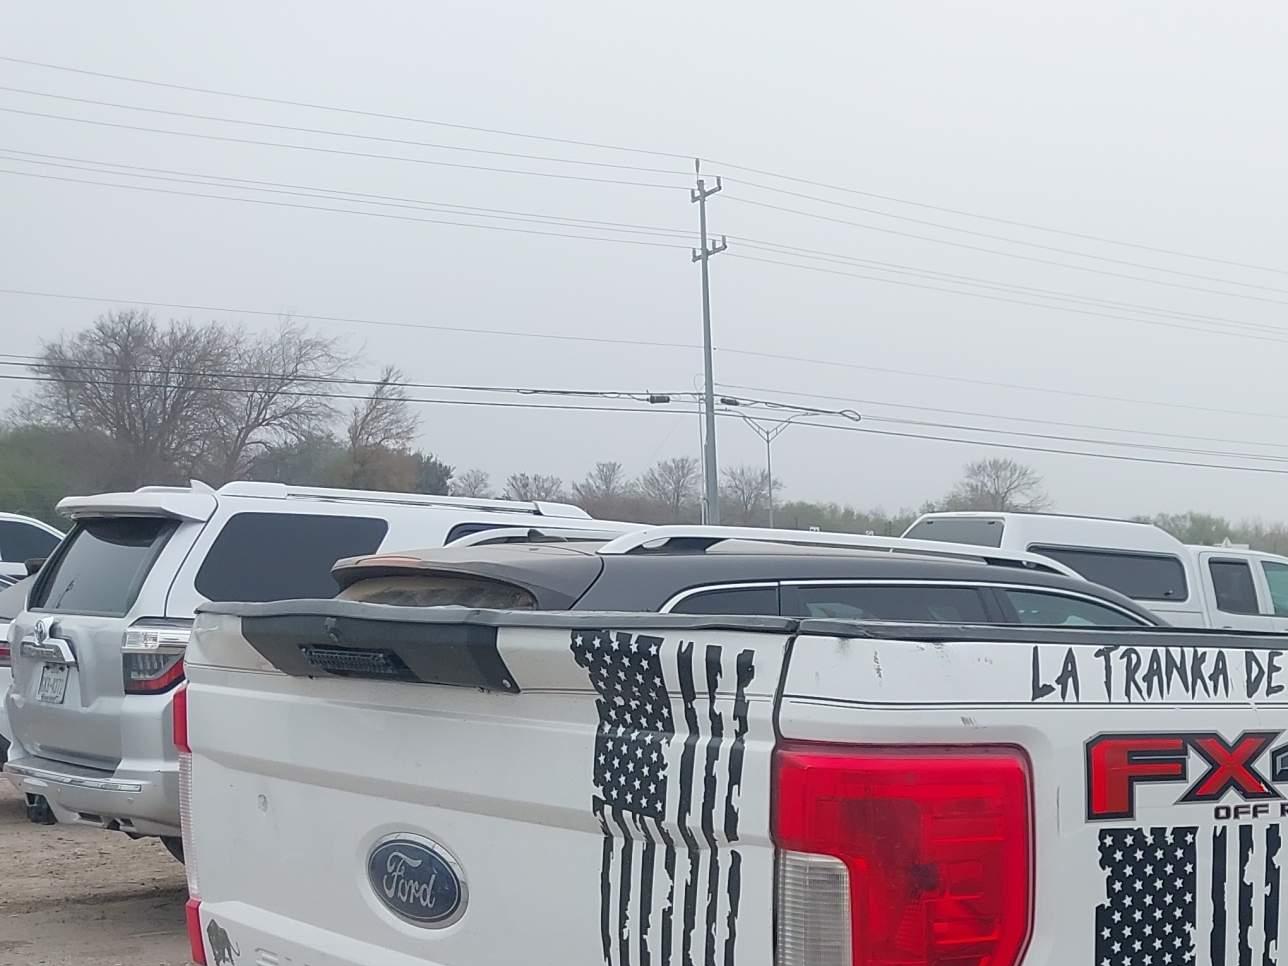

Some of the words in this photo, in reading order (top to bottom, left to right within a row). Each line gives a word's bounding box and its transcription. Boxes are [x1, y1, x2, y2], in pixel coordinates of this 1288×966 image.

[1031, 645, 1080, 702] LA
[1094, 645, 1229, 702] TRANKA
[1245, 650, 1285, 698] DE
[1213, 804, 1270, 821] OFF
[383, 851, 436, 908] Ford
